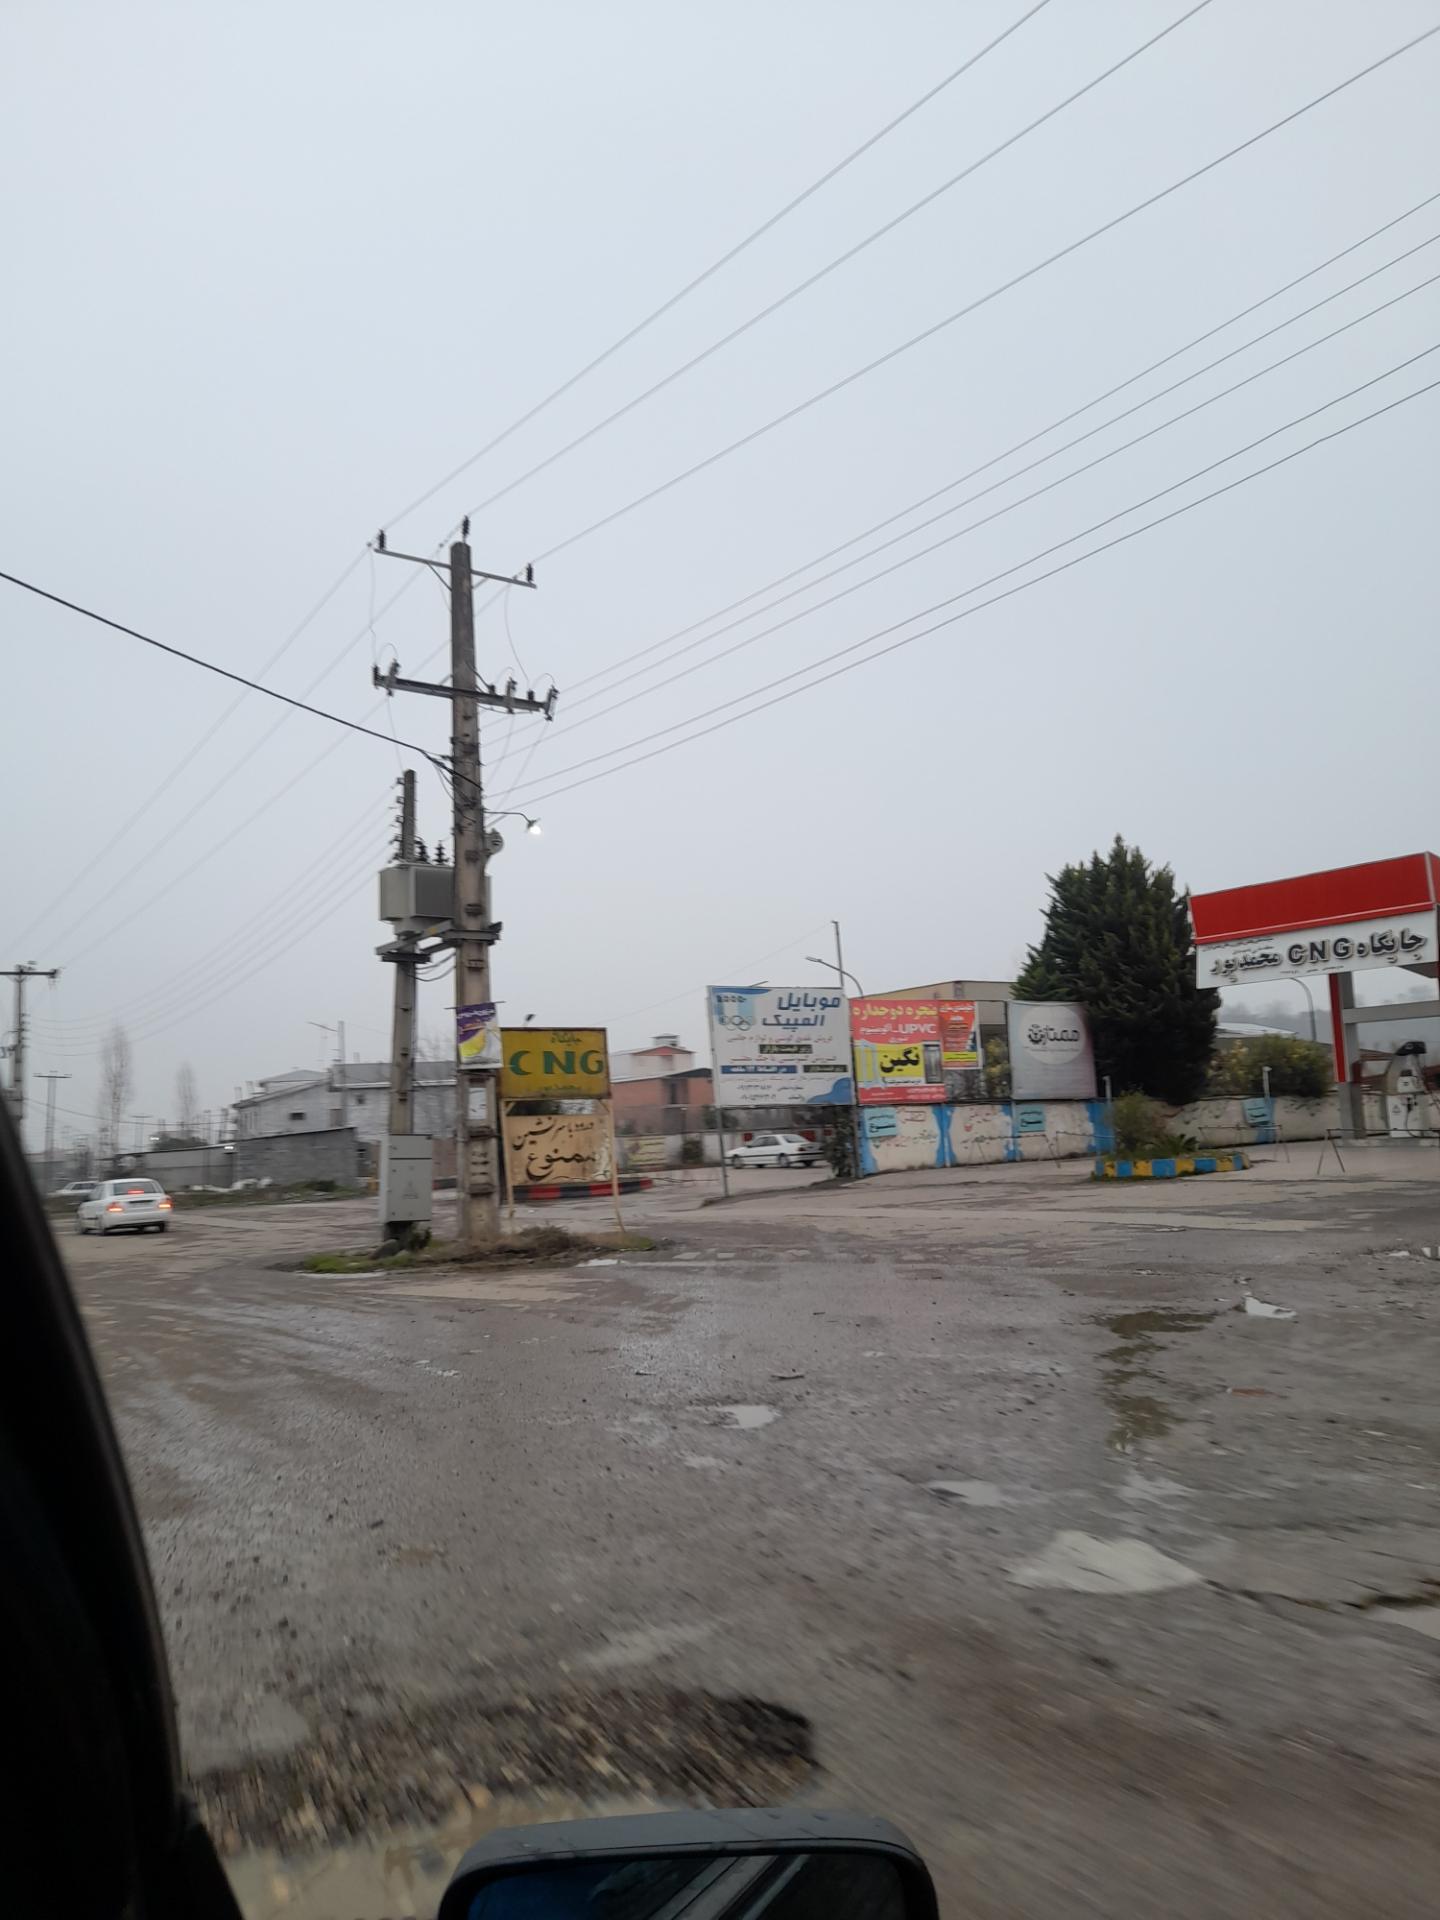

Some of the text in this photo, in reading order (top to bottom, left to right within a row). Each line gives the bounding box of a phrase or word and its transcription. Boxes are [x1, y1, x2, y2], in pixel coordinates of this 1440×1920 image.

[1288, 937, 1355, 965] CNG
[1358, 928, 1426, 964] جایگاه
[777, 992, 840, 1012] موبایل
[762, 1014, 825, 1033] المپیک
[897, 1022, 937, 1035] UPVC
[508, 1049, 604, 1076] CNG
[880, 1046, 920, 1073] نگین
[512, 1116, 566, 1150] سرنشین
[525, 1147, 598, 1182] ممنوع
